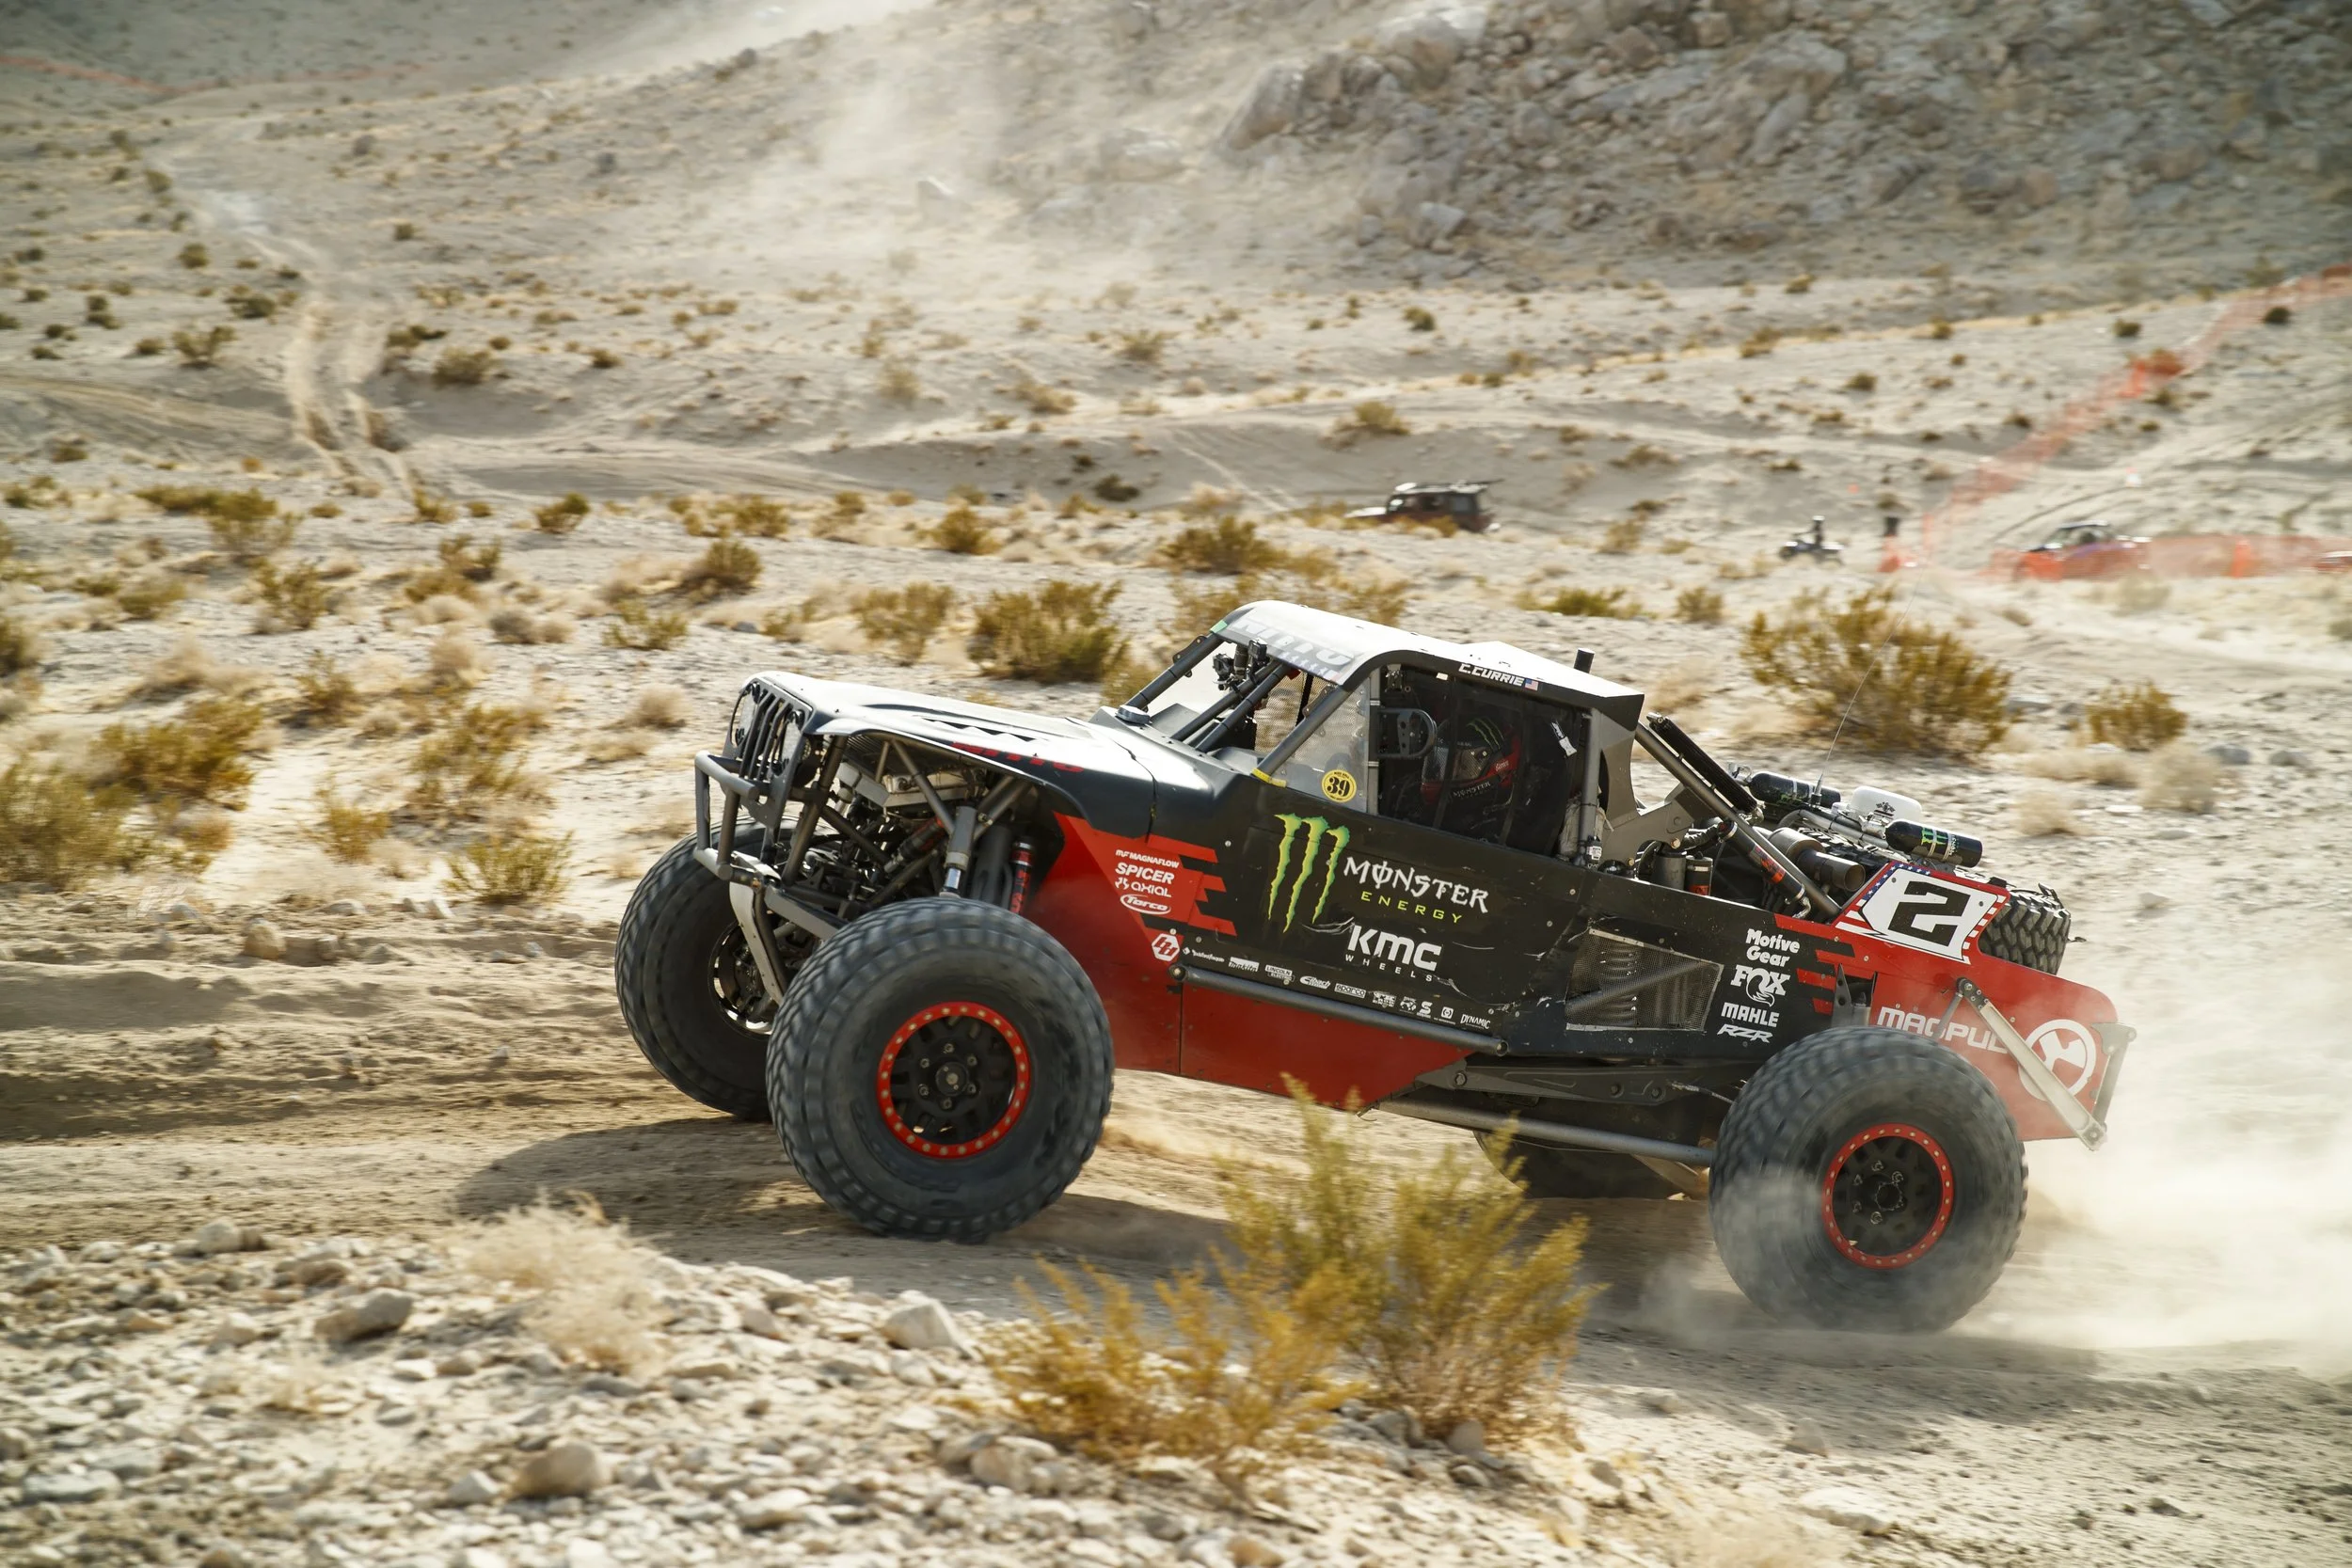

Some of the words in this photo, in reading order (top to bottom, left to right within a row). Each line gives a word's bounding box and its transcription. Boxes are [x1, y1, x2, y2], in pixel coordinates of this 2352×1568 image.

[1327, 776, 1350, 797] 39
[1129, 851, 1180, 869] MAGNAFLOW
[1115, 862, 1175, 884] SPICER
[1126, 894, 1168, 911] Torco
[1360, 891, 1462, 924] ENERGY
[1887, 880, 1971, 947] 2
[1347, 925, 1442, 972] KMC
[1745, 928, 1801, 954] Motive
[1345, 954, 1433, 982] WHEELS
[1746, 945, 1790, 968] Gear
[1265, 965, 1293, 976] LINCOLN
[1730, 964, 1791, 1007] FOX
[1460, 1014, 1491, 1030] DYNAMIC
[1721, 1002, 1780, 1027] MAHLE
[1716, 1023, 1773, 1043] RZR
